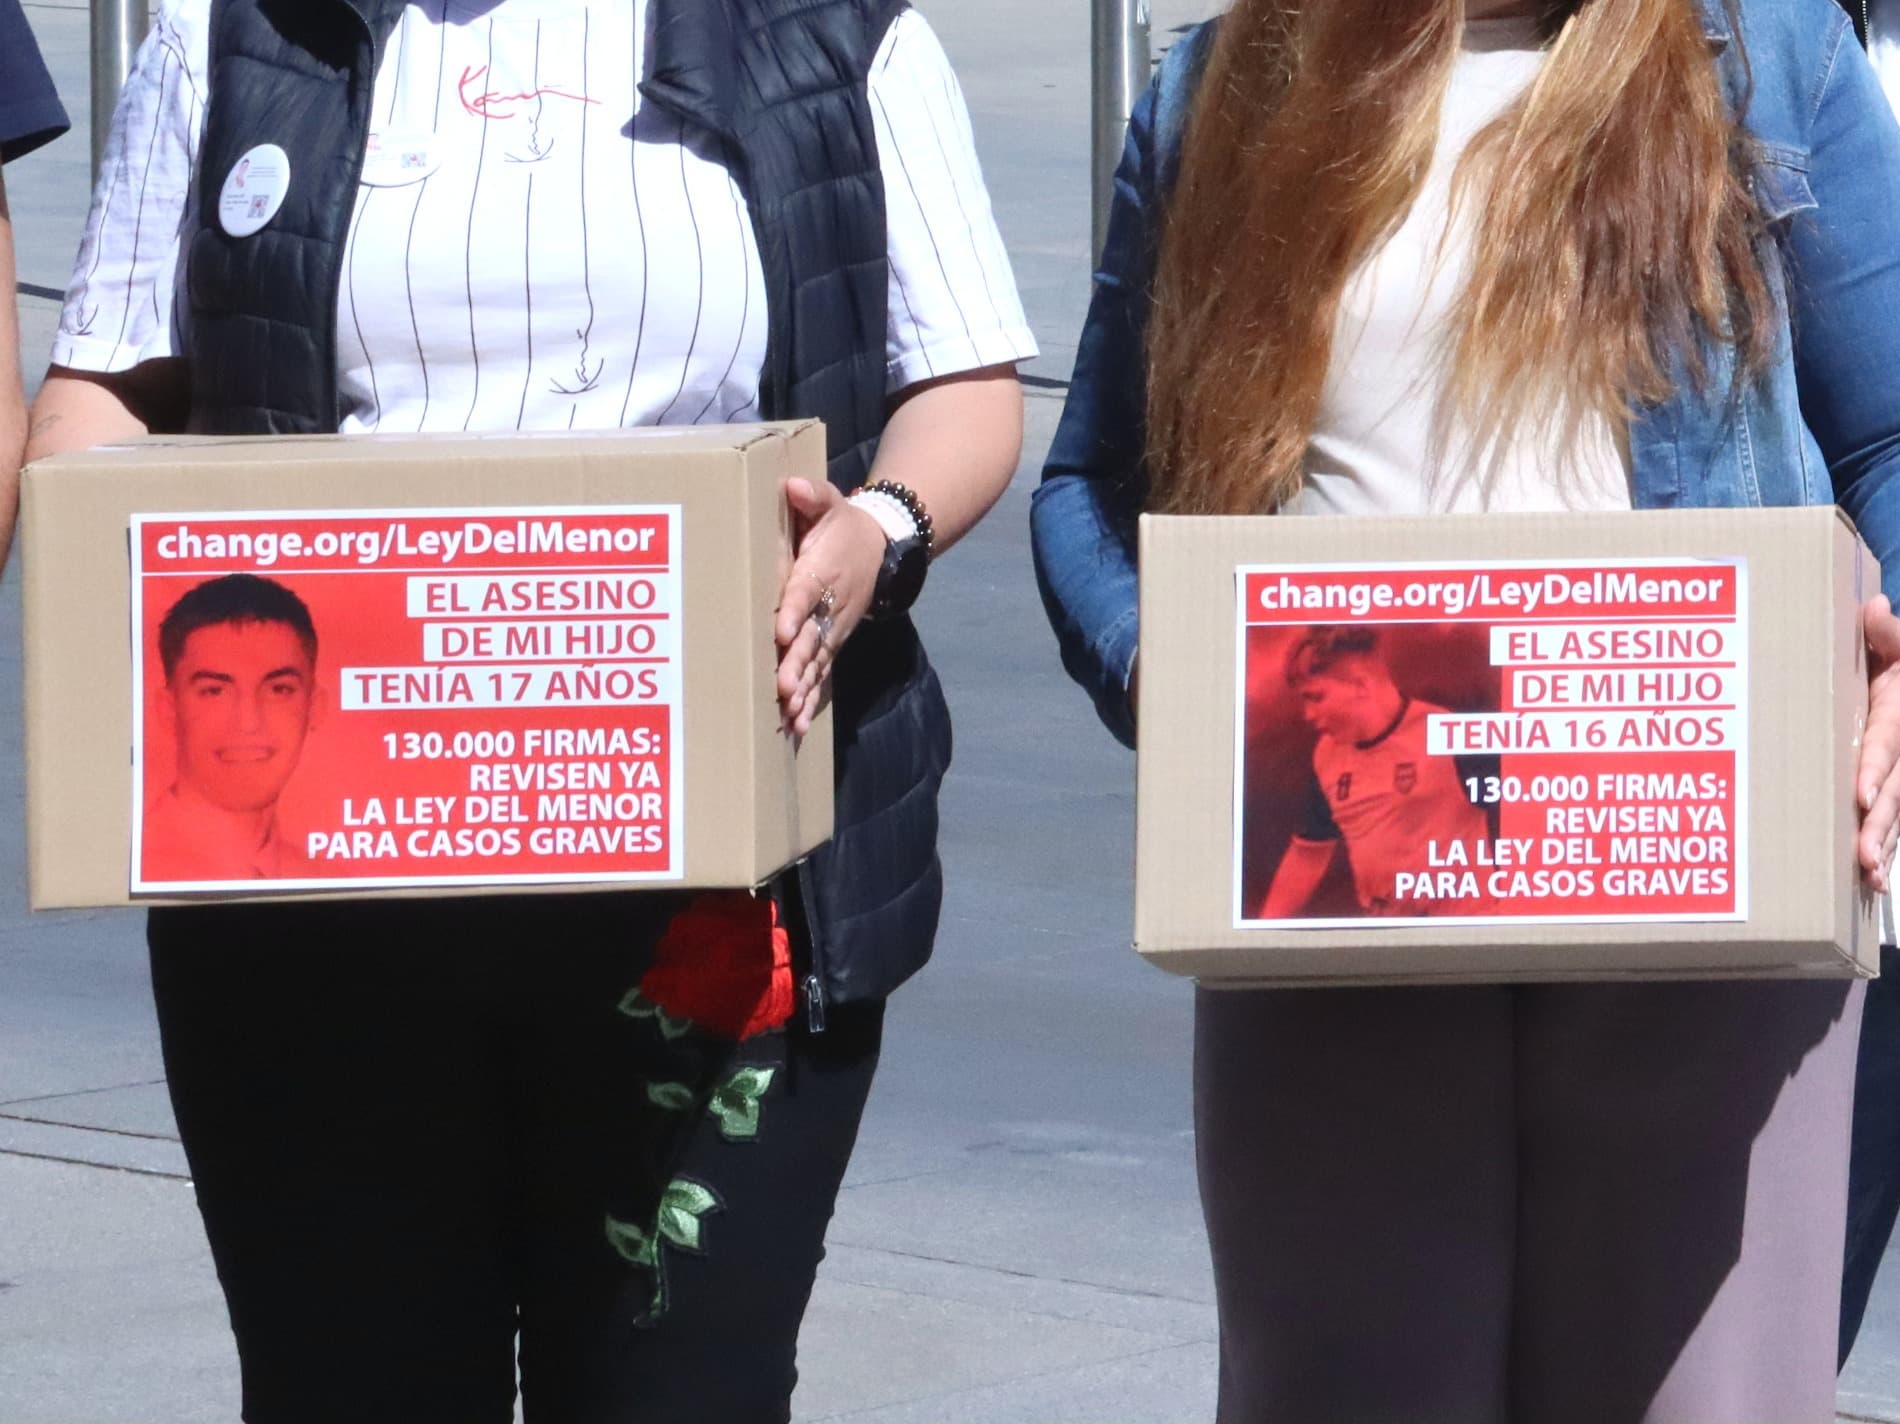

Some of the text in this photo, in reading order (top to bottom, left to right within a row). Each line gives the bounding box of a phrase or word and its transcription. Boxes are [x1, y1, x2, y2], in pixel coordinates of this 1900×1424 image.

[158, 521, 655, 565] change.org/LeyDelMenor
[427, 580, 655, 612] EL ASESINO
[1261, 573, 1722, 615] change.org/LeyDelMenor
[442, 624, 655, 657] DE MI HIJO
[1509, 629, 1723, 660] EL ASESINO
[355, 663, 658, 704] TENÍA 17 AÑOS
[1522, 673, 1722, 703] DE MI HIJO
[384, 728, 660, 758] 130.000 FIRMAS:
[1440, 710, 1725, 749] TENÍA 16 AÑOS
[471, 762, 660, 790] REVISEN YA
[1466, 773, 1726, 802] 130.000 FIRMAS:
[344, 793, 661, 825] LA LEY DEL MENOR
[1547, 806, 1726, 833] REVISEN YA
[309, 826, 662, 858] PARA CASOS GRAVES
[1429, 837, 1727, 866] LA LEY DEL MENOR
[1396, 868, 1728, 898] PARA CASOS GRAVES
